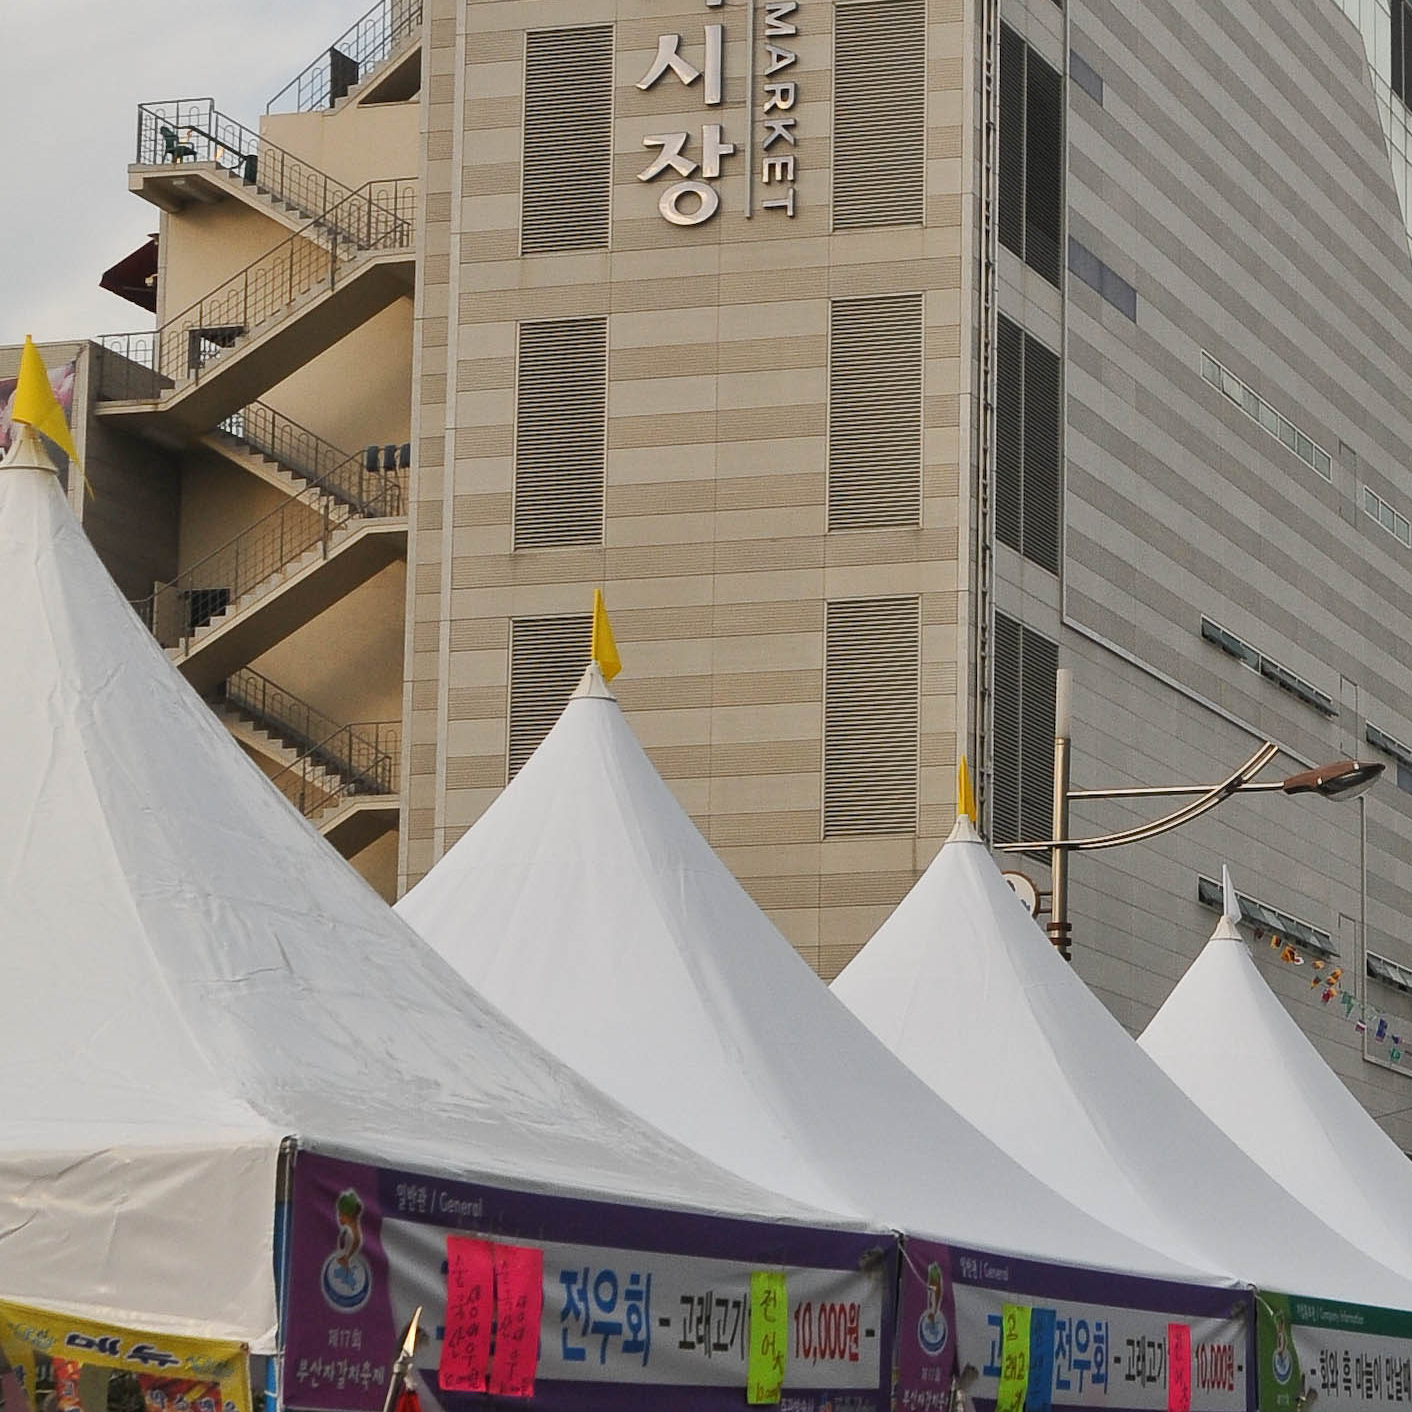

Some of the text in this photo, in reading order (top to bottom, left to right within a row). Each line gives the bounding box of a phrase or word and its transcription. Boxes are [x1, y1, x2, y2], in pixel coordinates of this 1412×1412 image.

[761, 1, 798, 218] MARKET
[439, 1190, 484, 1218] General
[560, 1267, 861, 1367] 전우회 고래고기 10,000원
[296, 1357, 386, 1389] 부산자갈치축제
[1125, 1336, 1167, 1390] 고래고기
[1195, 1343, 1235, 1394] 10,000원
